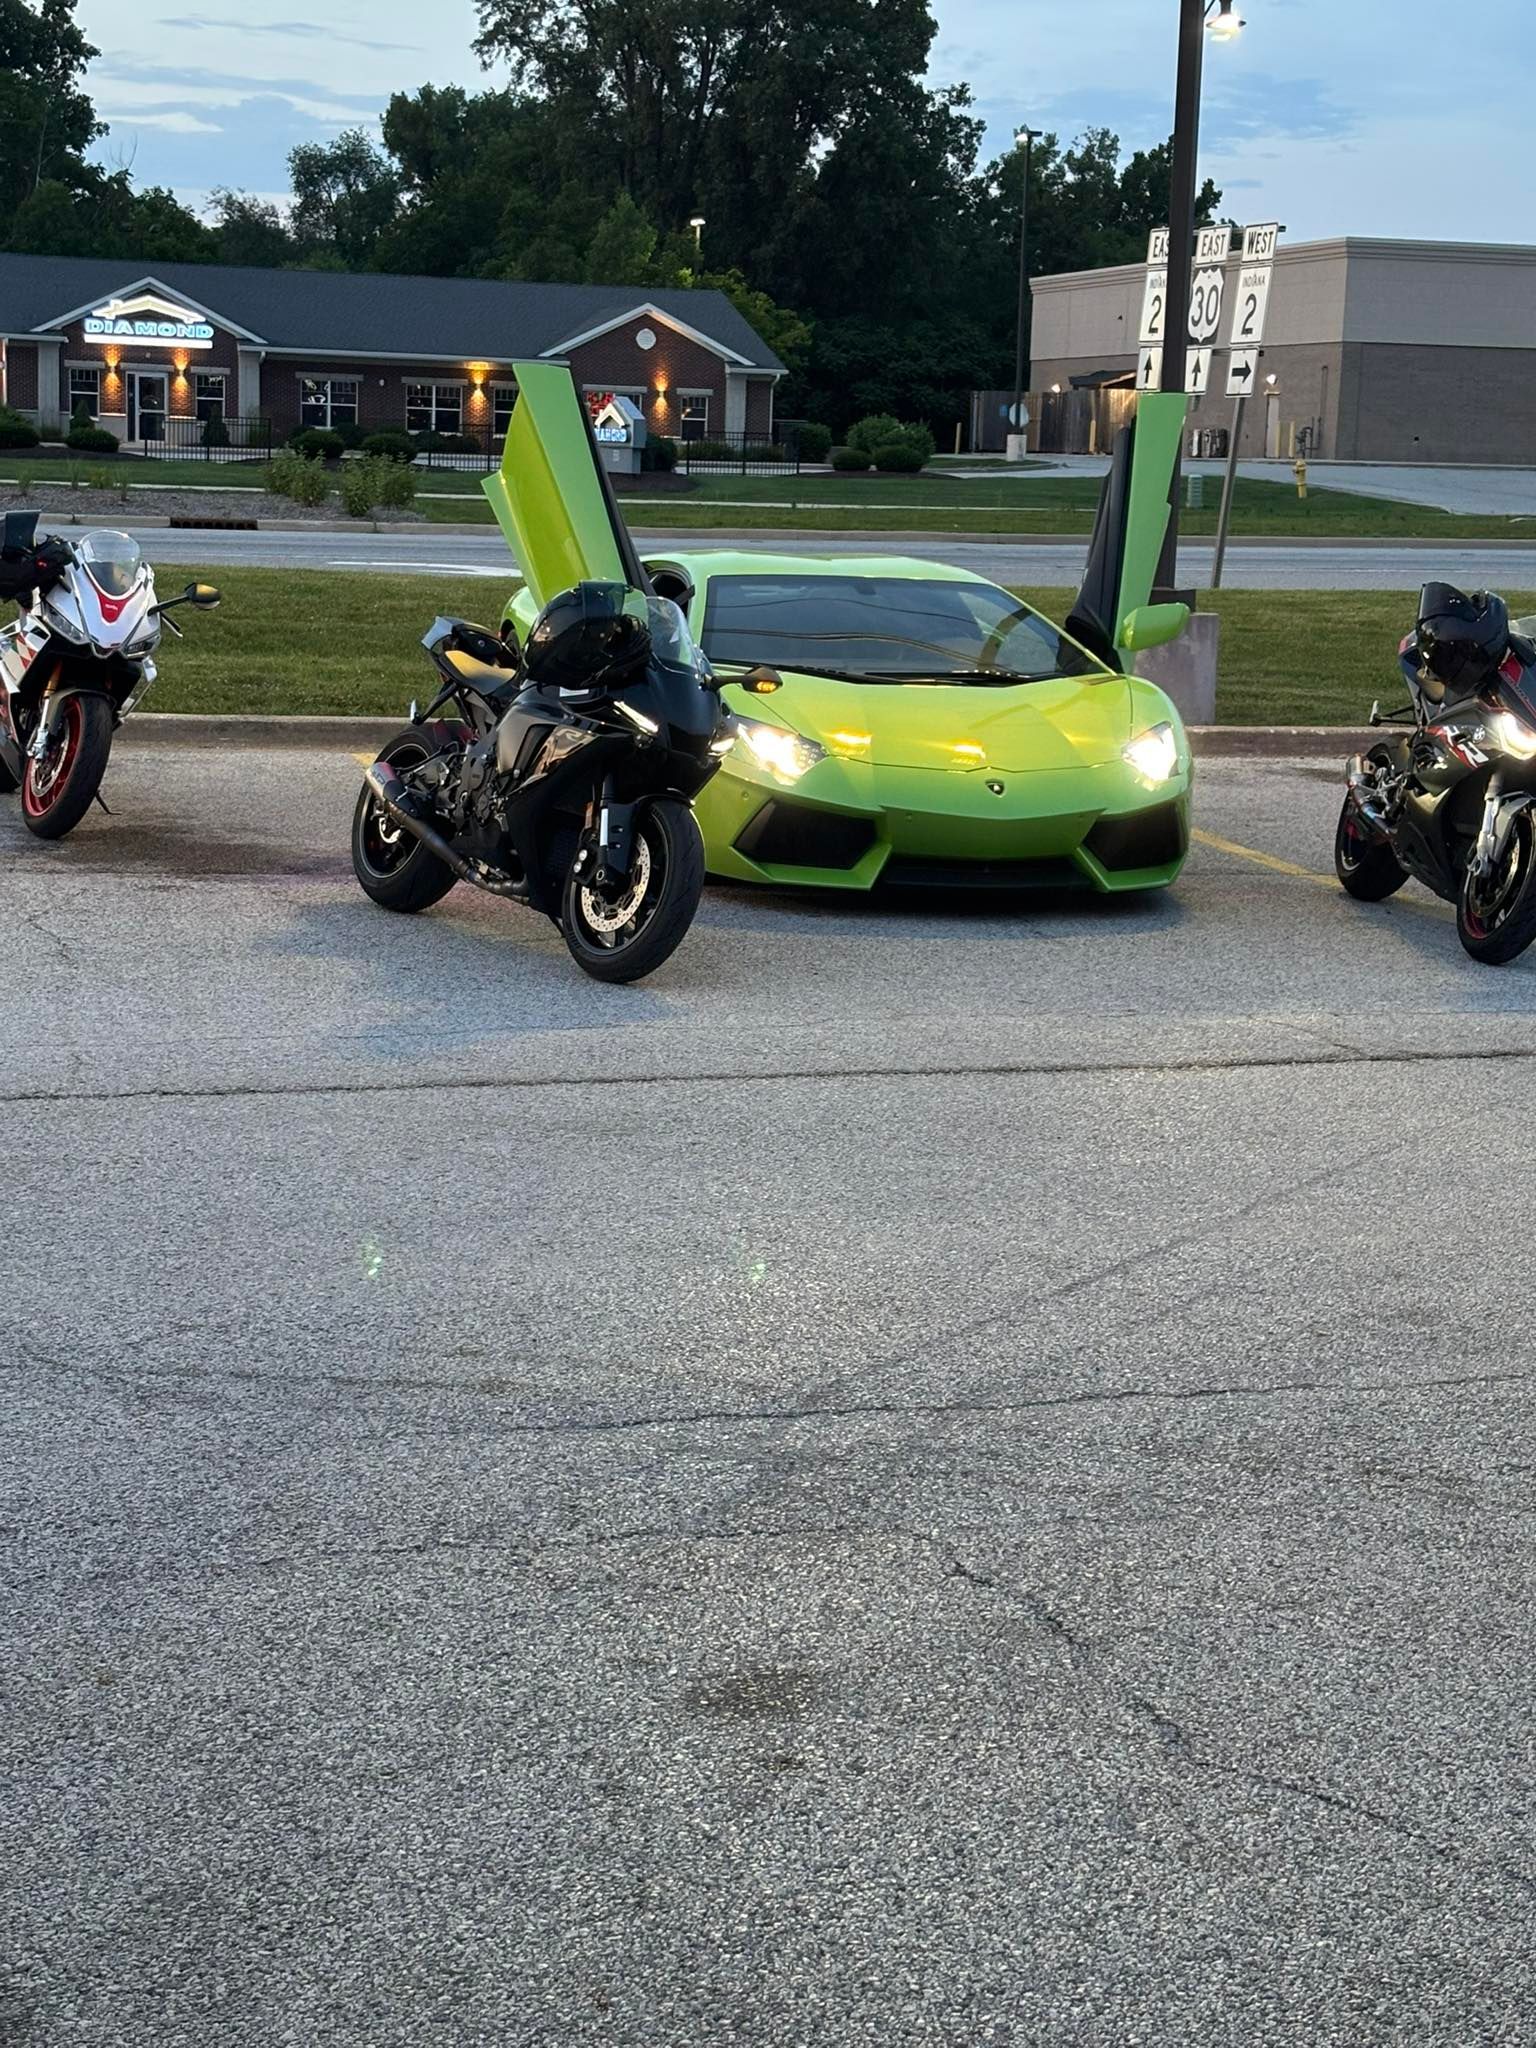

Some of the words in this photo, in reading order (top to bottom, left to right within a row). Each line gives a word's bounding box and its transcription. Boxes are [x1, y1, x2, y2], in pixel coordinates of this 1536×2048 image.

[1153, 235, 1170, 258] EAS
[1201, 234, 1226, 257] EAST
[1247, 231, 1274, 255] WEST
[1242, 274, 1266, 288] INDIANA
[1148, 294, 1162, 334] 2
[1191, 284, 1219, 327] 30
[1241, 293, 1257, 335] 2
[84, 318, 214, 339] DIAMOND
